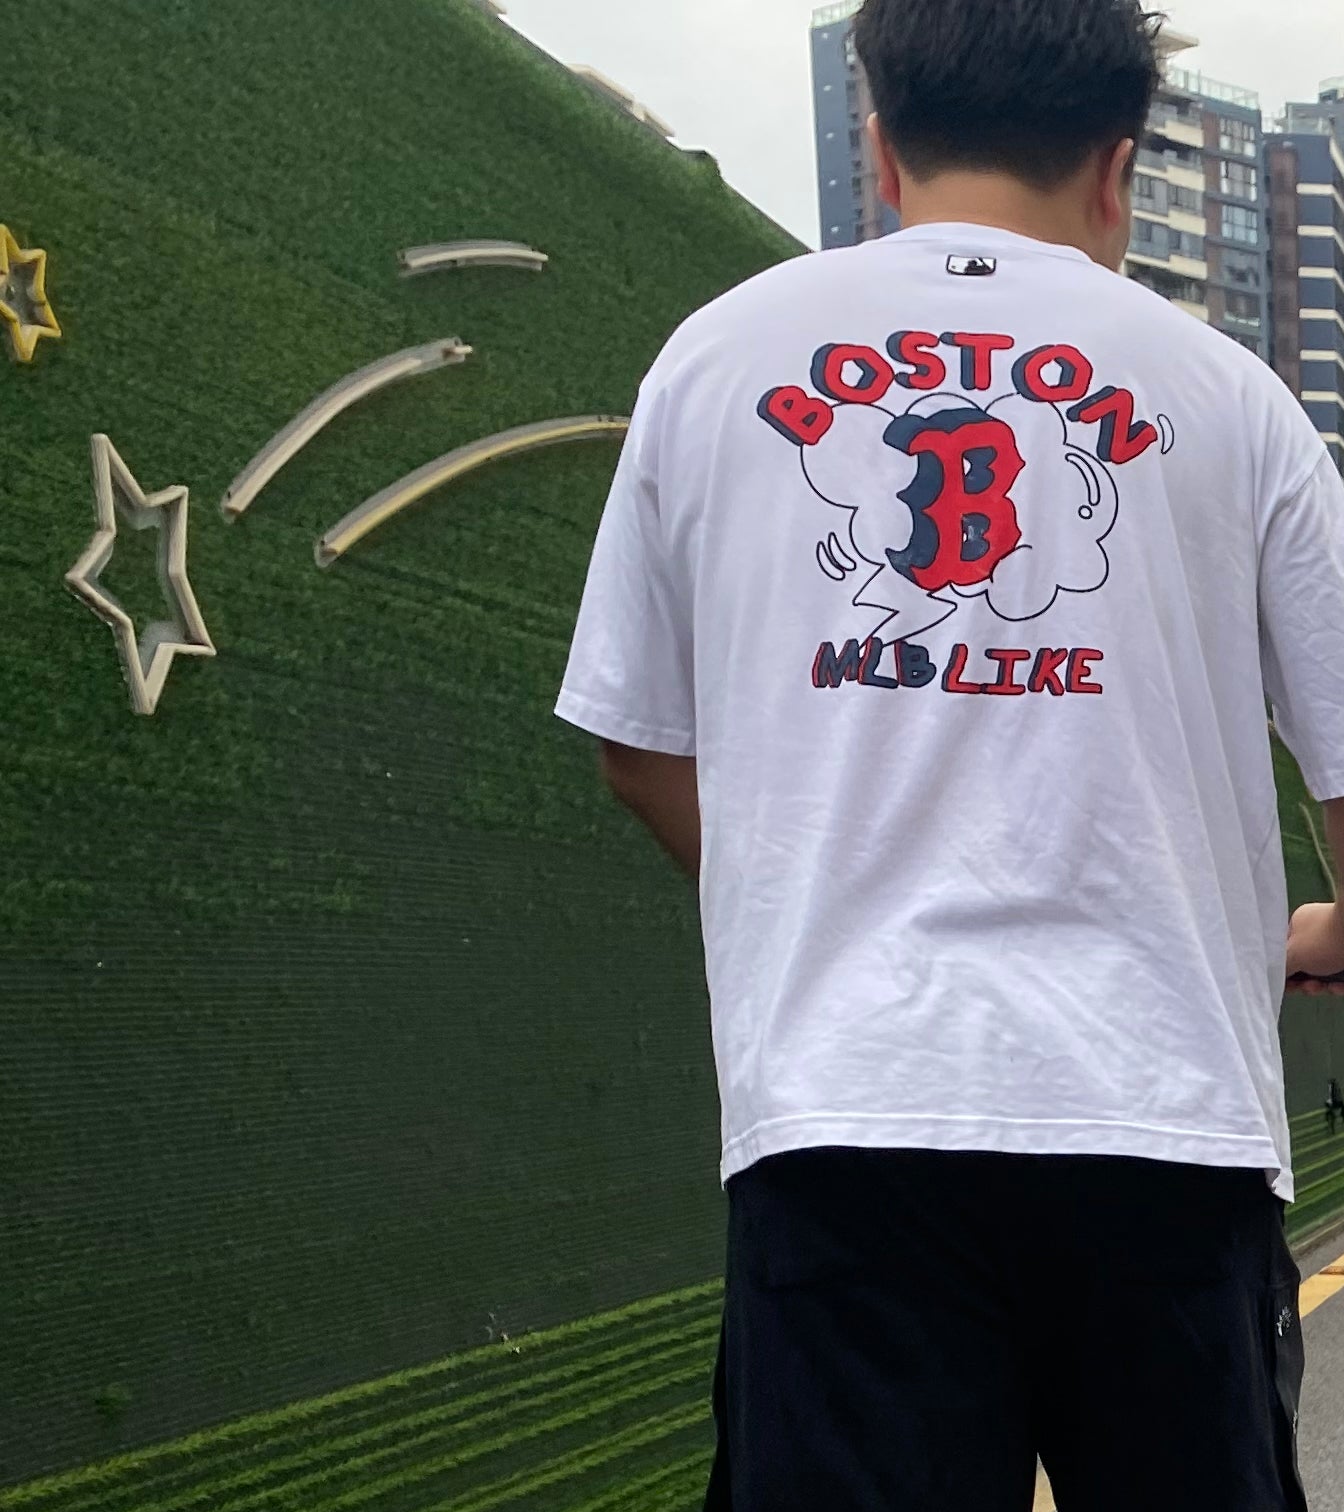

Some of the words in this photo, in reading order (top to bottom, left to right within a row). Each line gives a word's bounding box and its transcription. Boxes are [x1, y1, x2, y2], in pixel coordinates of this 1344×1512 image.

[757, 330, 1158, 463] BOSTON
[883, 408, 1026, 592] B
[813, 636, 937, 688] MLB
[941, 644, 1104, 695] LIKE
